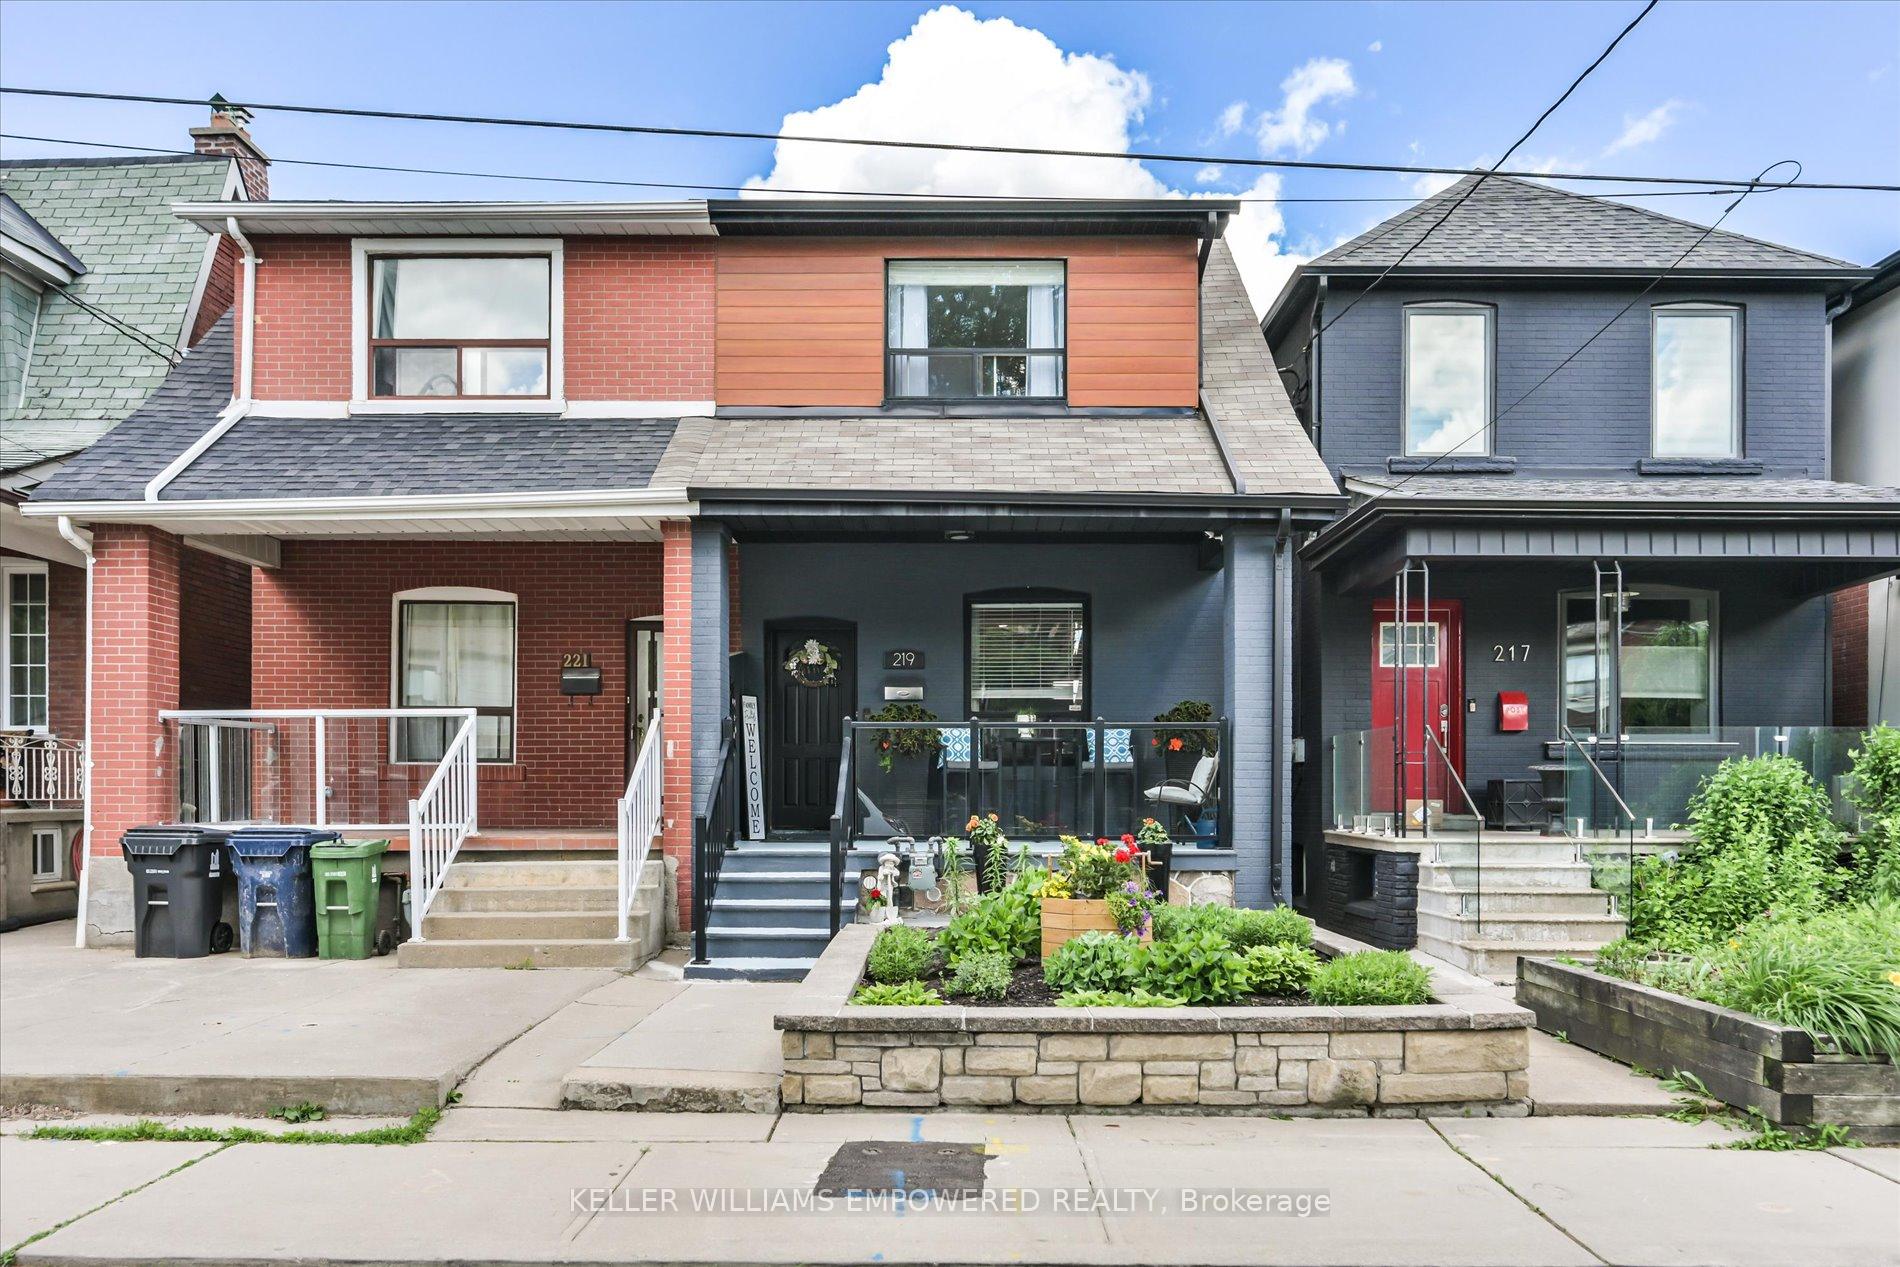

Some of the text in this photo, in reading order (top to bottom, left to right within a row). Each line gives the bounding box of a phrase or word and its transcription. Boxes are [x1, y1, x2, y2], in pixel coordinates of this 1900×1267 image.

[563, 653, 588, 667] 221
[893, 652, 915, 666] 219
[1493, 645, 1530, 662] 217
[745, 723, 760, 834] WELCOME
